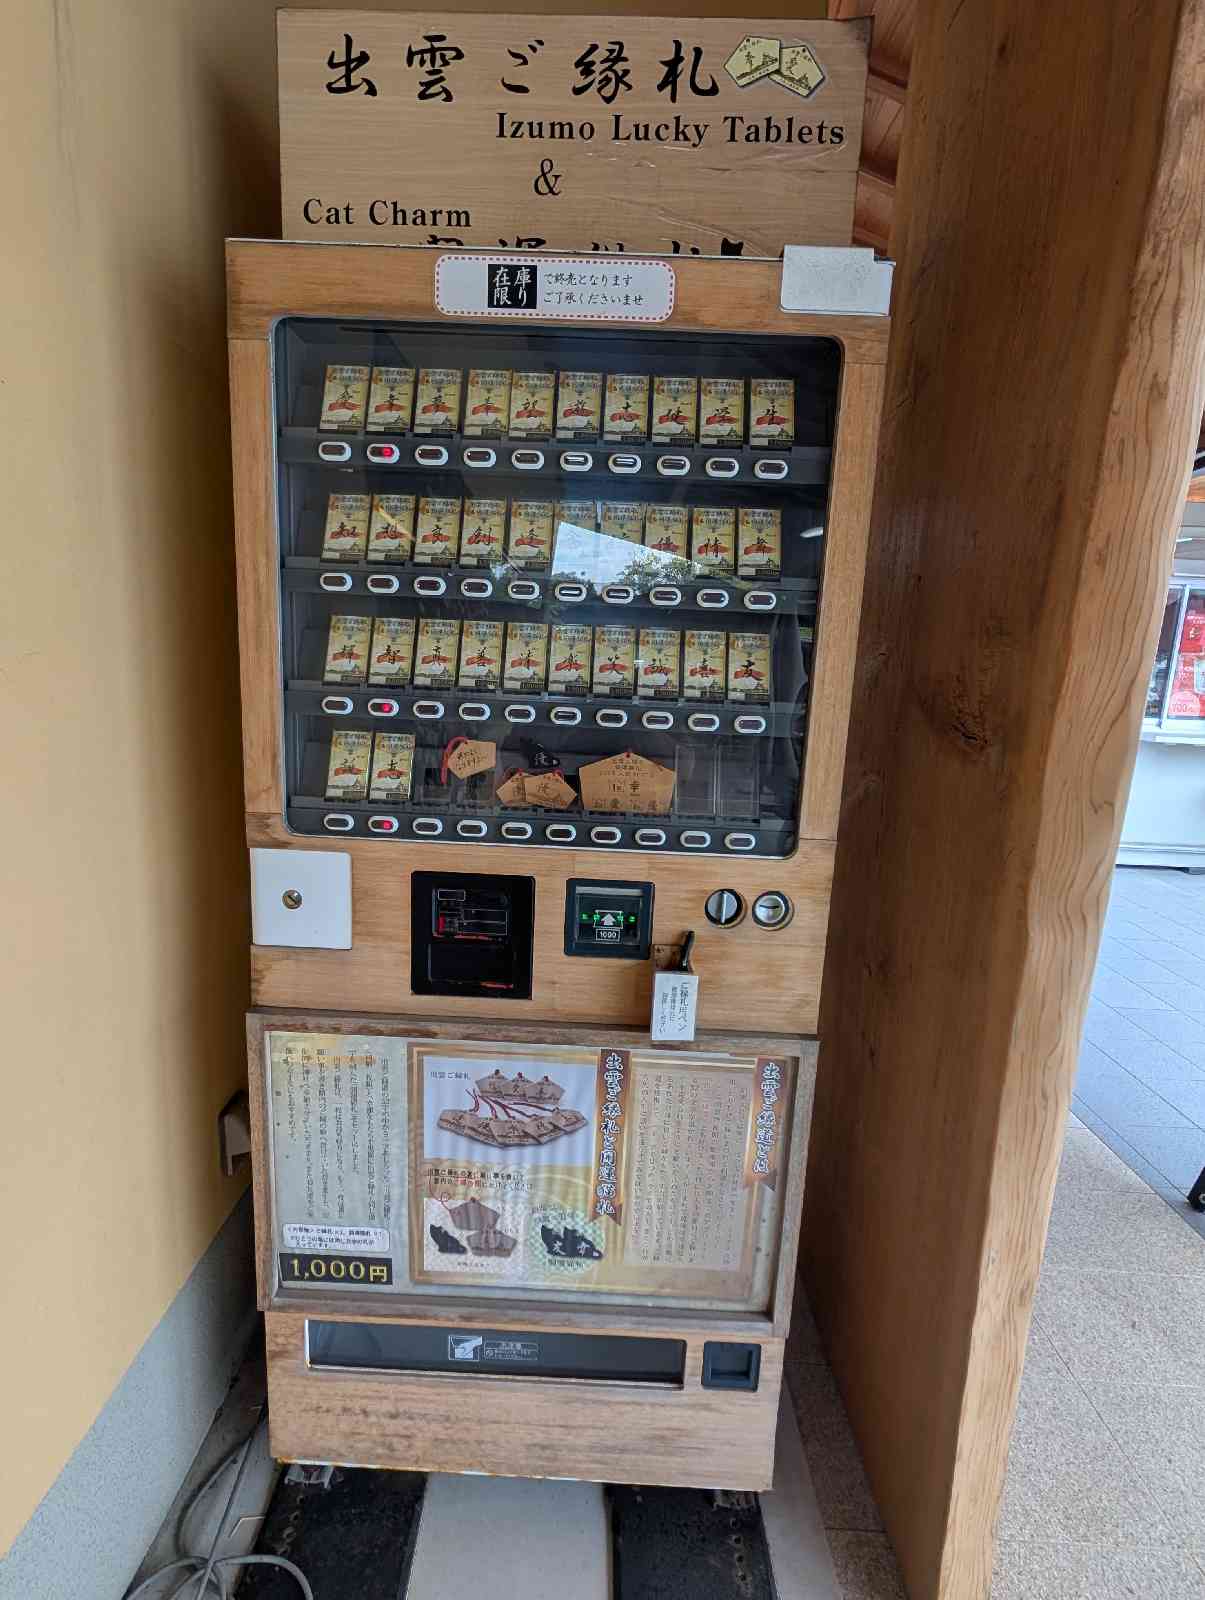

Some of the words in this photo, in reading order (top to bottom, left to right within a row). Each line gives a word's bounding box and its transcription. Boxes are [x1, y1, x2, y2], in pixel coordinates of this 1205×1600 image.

[325, 33, 720, 105] 出雲ご縁札
[495, 112, 595, 141] Izumo
[611, 114, 711, 149] Lucky
[722, 115, 845, 145] Tablets
[533, 158, 563, 196] &
[303, 198, 355, 225] Cat
[368, 199, 472, 228] Charm
[599, 930, 617, 939] 1000
[290, 1257, 388, 1283] 1,000円
